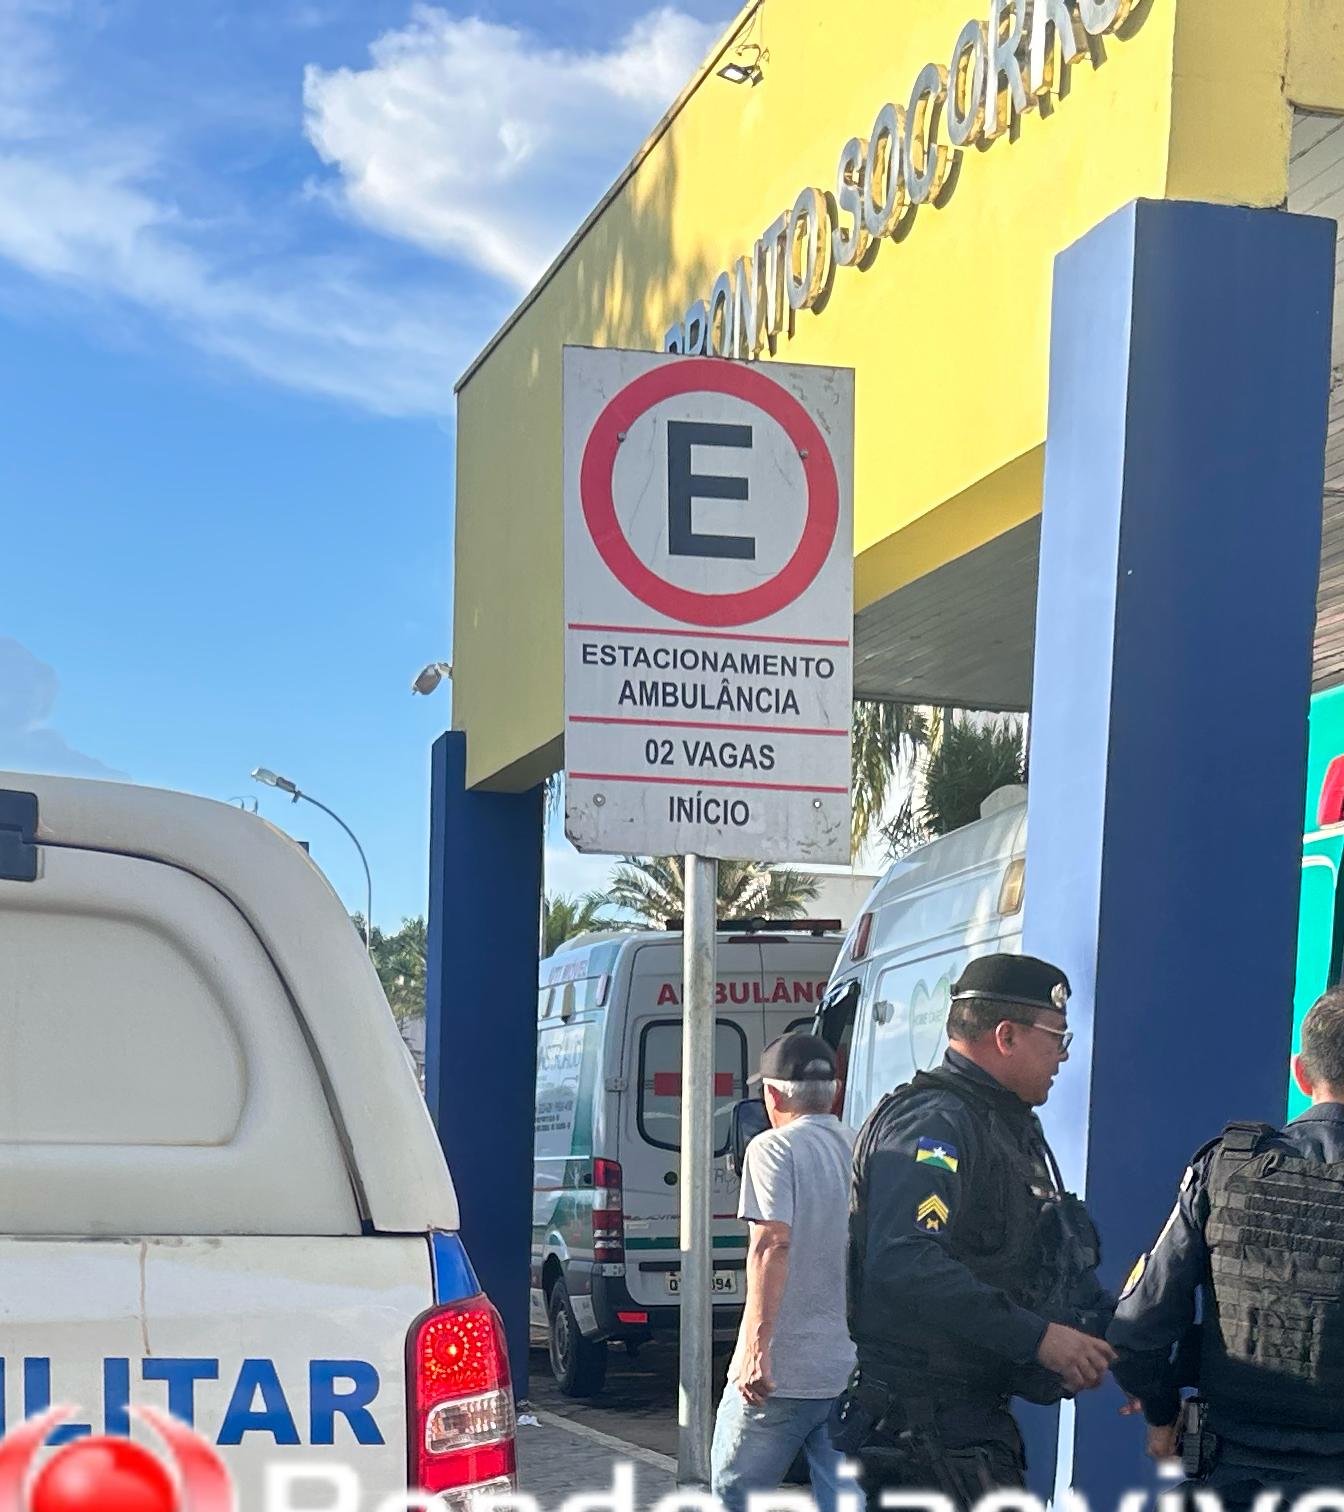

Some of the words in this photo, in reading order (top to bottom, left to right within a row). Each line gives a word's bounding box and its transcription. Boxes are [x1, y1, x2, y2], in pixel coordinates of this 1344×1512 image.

[666, 420, 756, 561] E
[582, 643, 835, 679] ESTACIONAMENTO
[618, 678, 801, 716] AMBULÂNCIA
[645, 739, 674, 765] 02
[683, 741, 776, 770] VAGAS
[669, 790, 750, 827] INÍCIO
